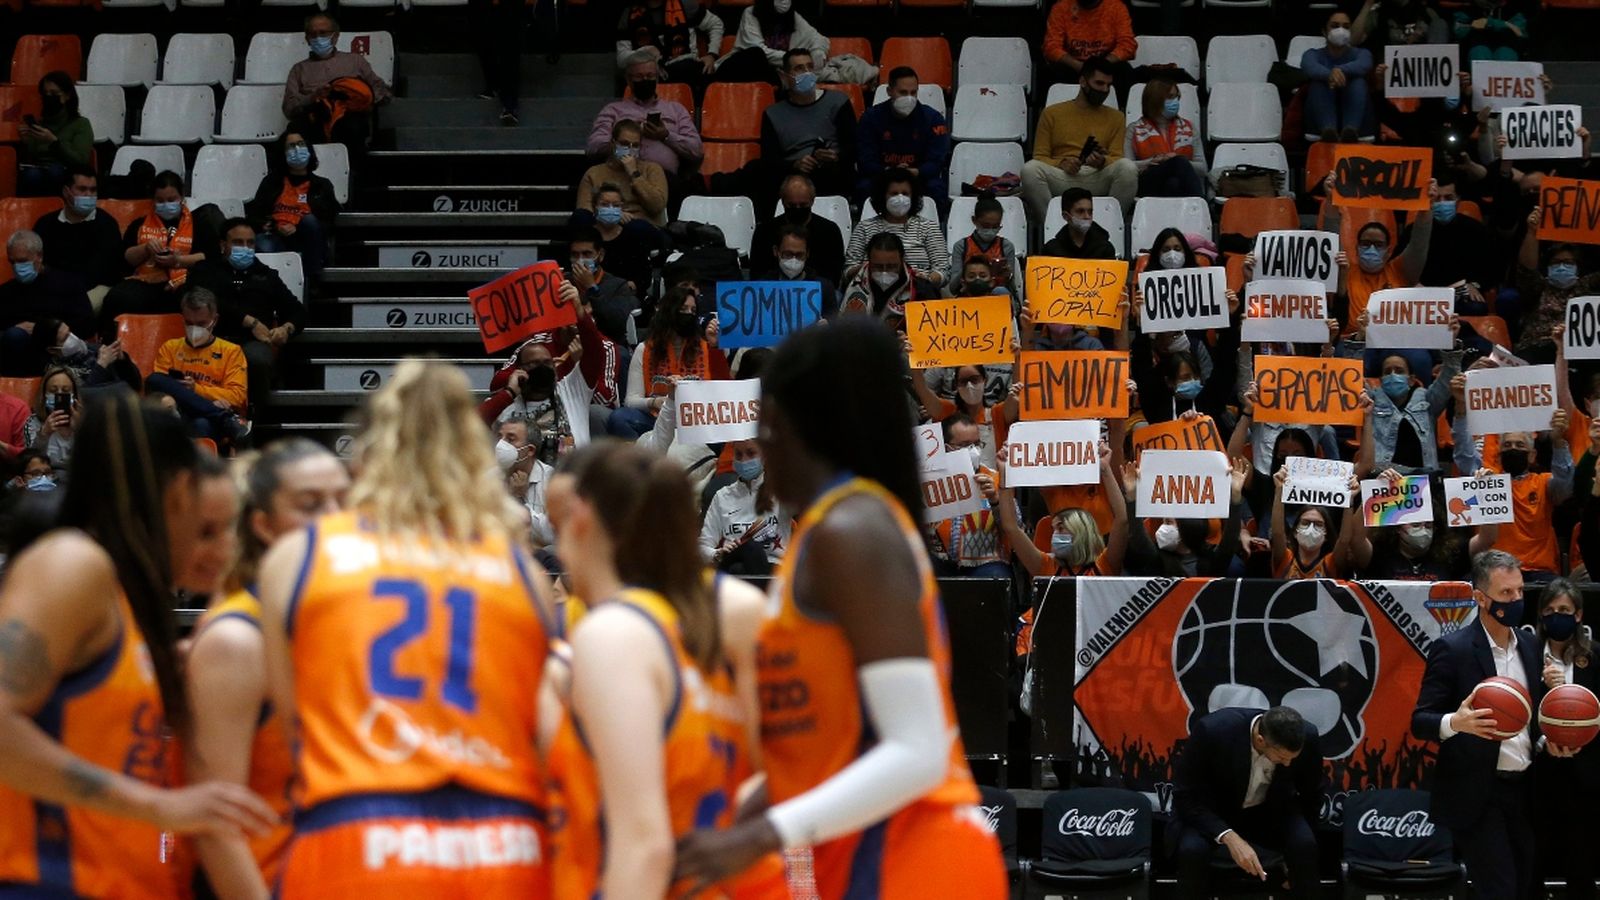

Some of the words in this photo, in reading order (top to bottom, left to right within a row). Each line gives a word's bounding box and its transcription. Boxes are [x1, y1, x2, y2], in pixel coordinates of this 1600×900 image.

[1390, 51, 1453, 88] ÁNIMO
[1482, 76, 1535, 99] JEFAS
[1507, 109, 1575, 149] GRACIES
[459, 200, 519, 212] ZURICH
[439, 255, 499, 268] ZURICH
[1261, 235, 1331, 281] VAMOS
[1032, 266, 1117, 291] PROUD
[473, 270, 567, 339] EQUIPO
[1048, 298, 1119, 319] OPAL!
[1145, 273, 1221, 321] ORGULL
[1247, 294, 1325, 320] SEMPRE
[414, 312, 477, 325] ZURICH
[1372, 301, 1450, 325] JUNTES
[1568, 302, 1600, 347] RO
[1024, 358, 1128, 412] AMUNT
[1468, 384, 1553, 411] GRANDES
[680, 399, 761, 427] GRACIAS
[1009, 441, 1096, 468] CLAUDIA
[921, 473, 972, 507] OUD
[1151, 475, 1216, 505] ANNA
[1286, 485, 1345, 505] ÁNIMO
[1372, 485, 1420, 499] PROUD
[1462, 475, 1505, 491] PODÉIS
[1371, 501, 1389, 513] OF
[1393, 498, 1424, 510] YOU
[1485, 492, 1507, 503] CON
[1479, 506, 1509, 516] TODO
[368, 577, 478, 714] 21
